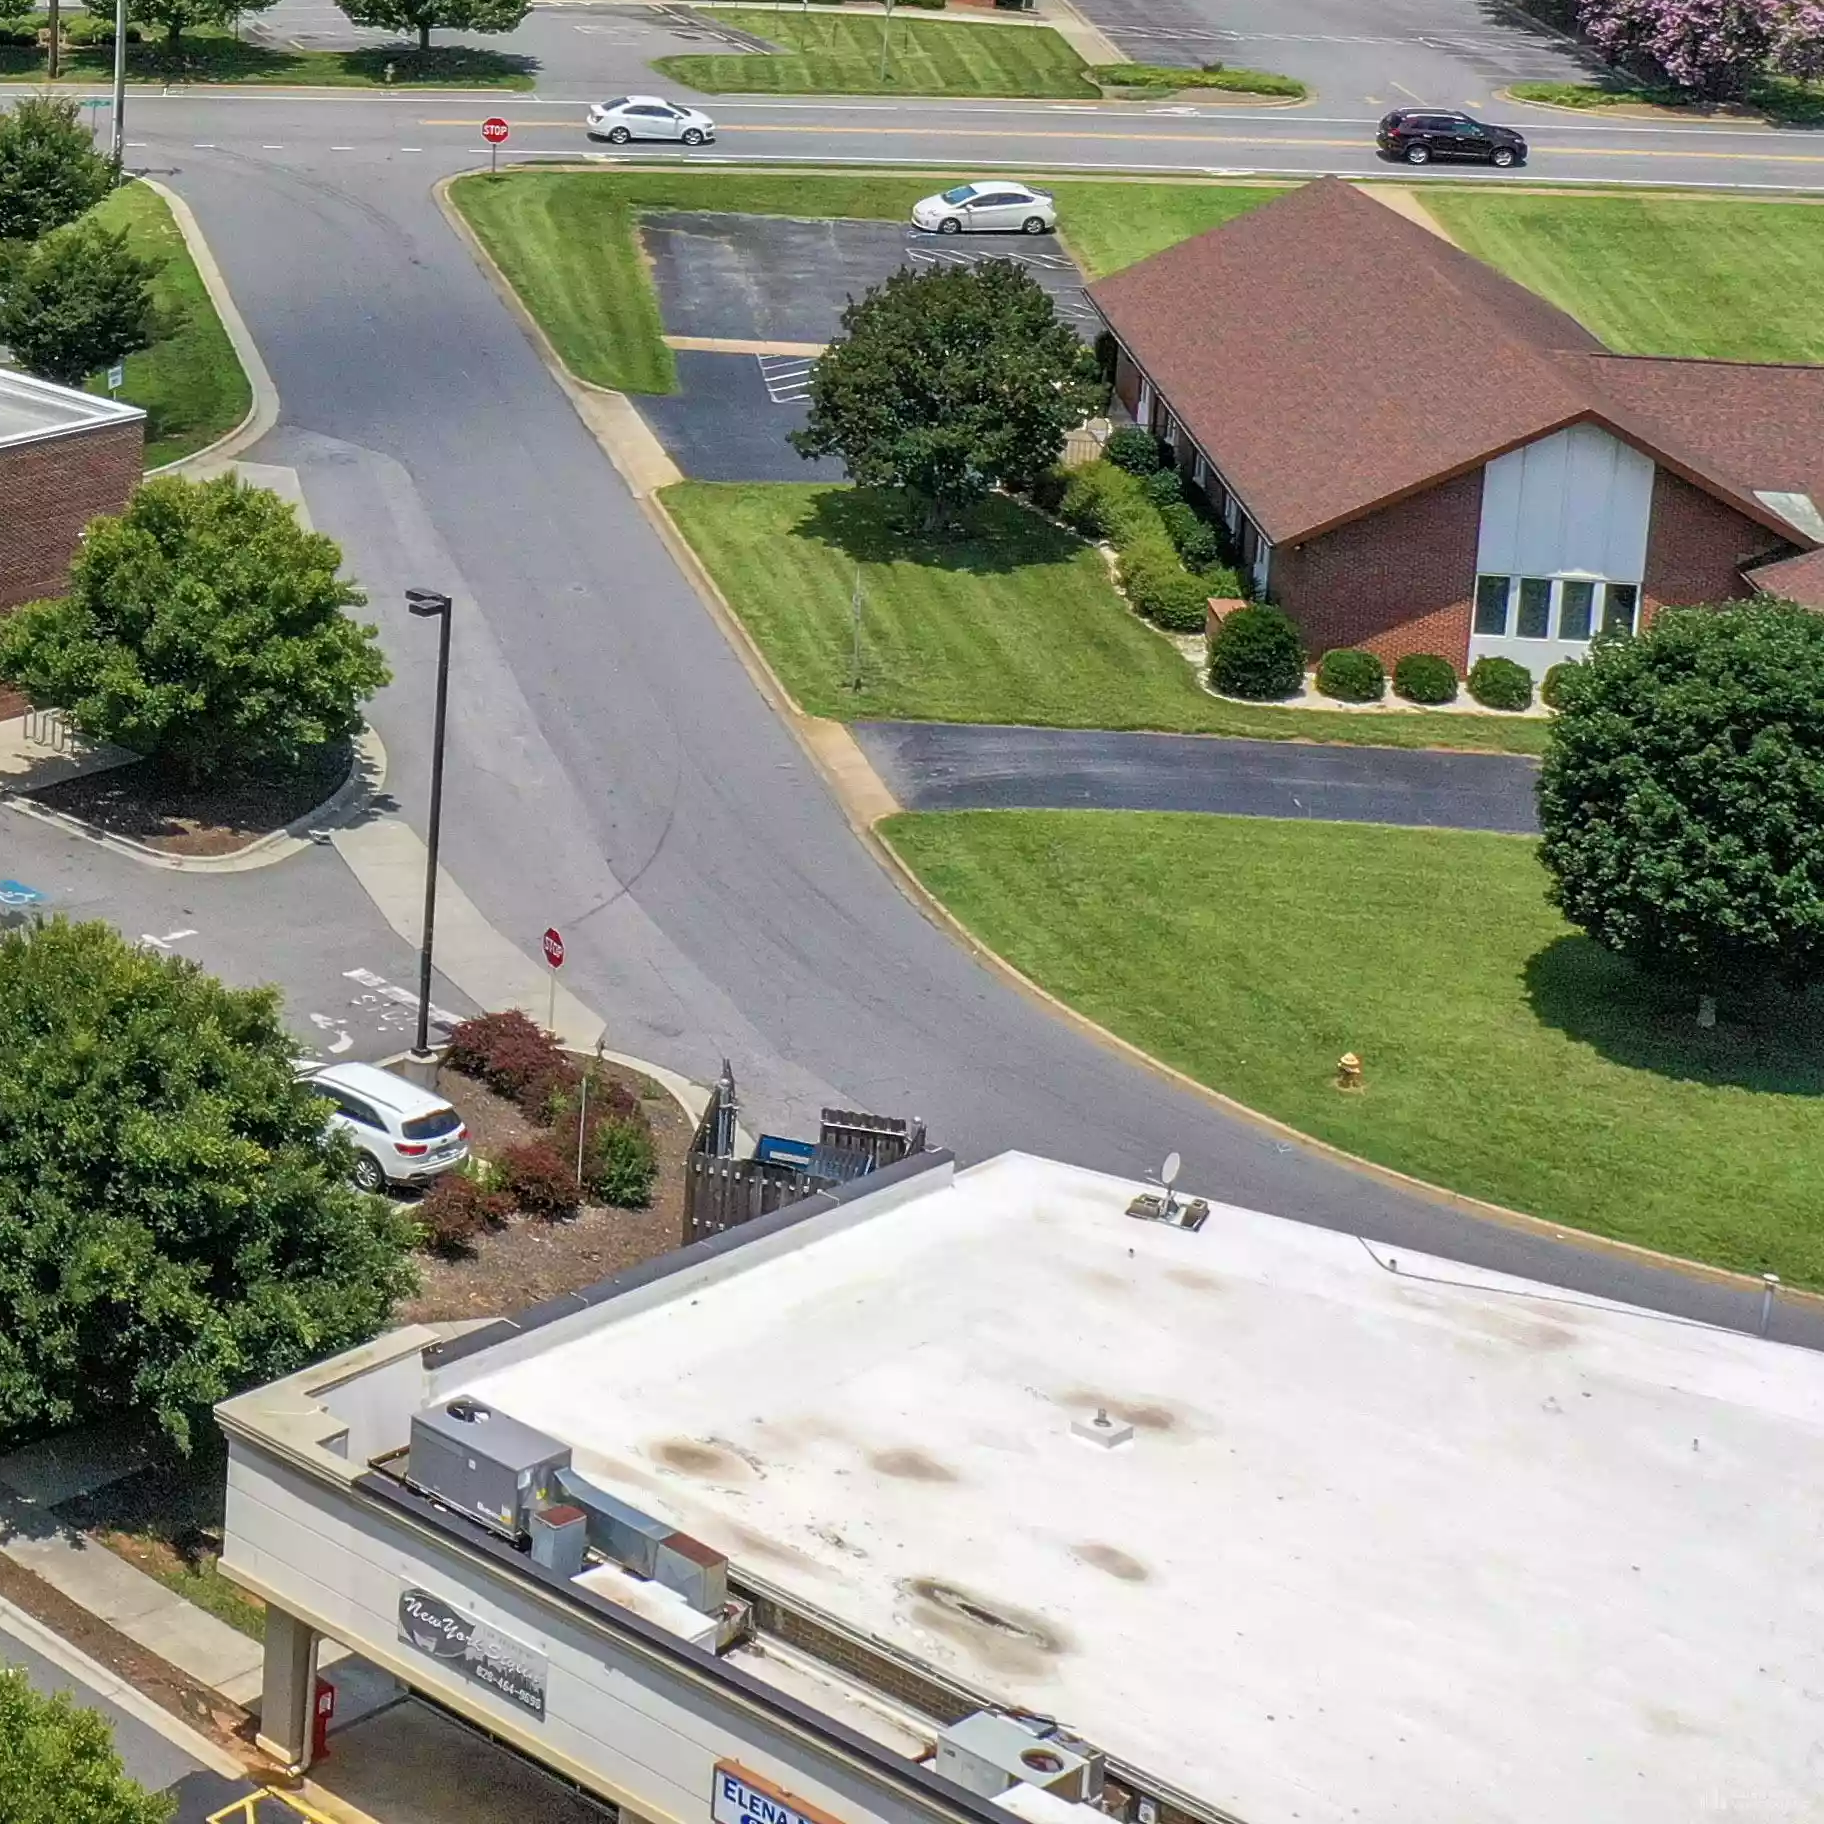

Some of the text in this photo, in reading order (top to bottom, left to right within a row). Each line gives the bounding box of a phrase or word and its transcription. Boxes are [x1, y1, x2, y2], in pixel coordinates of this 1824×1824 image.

[483, 125, 508, 136] STOP
[545, 936, 564, 960] STOP
[723, 1777, 788, 1824] ELENA
